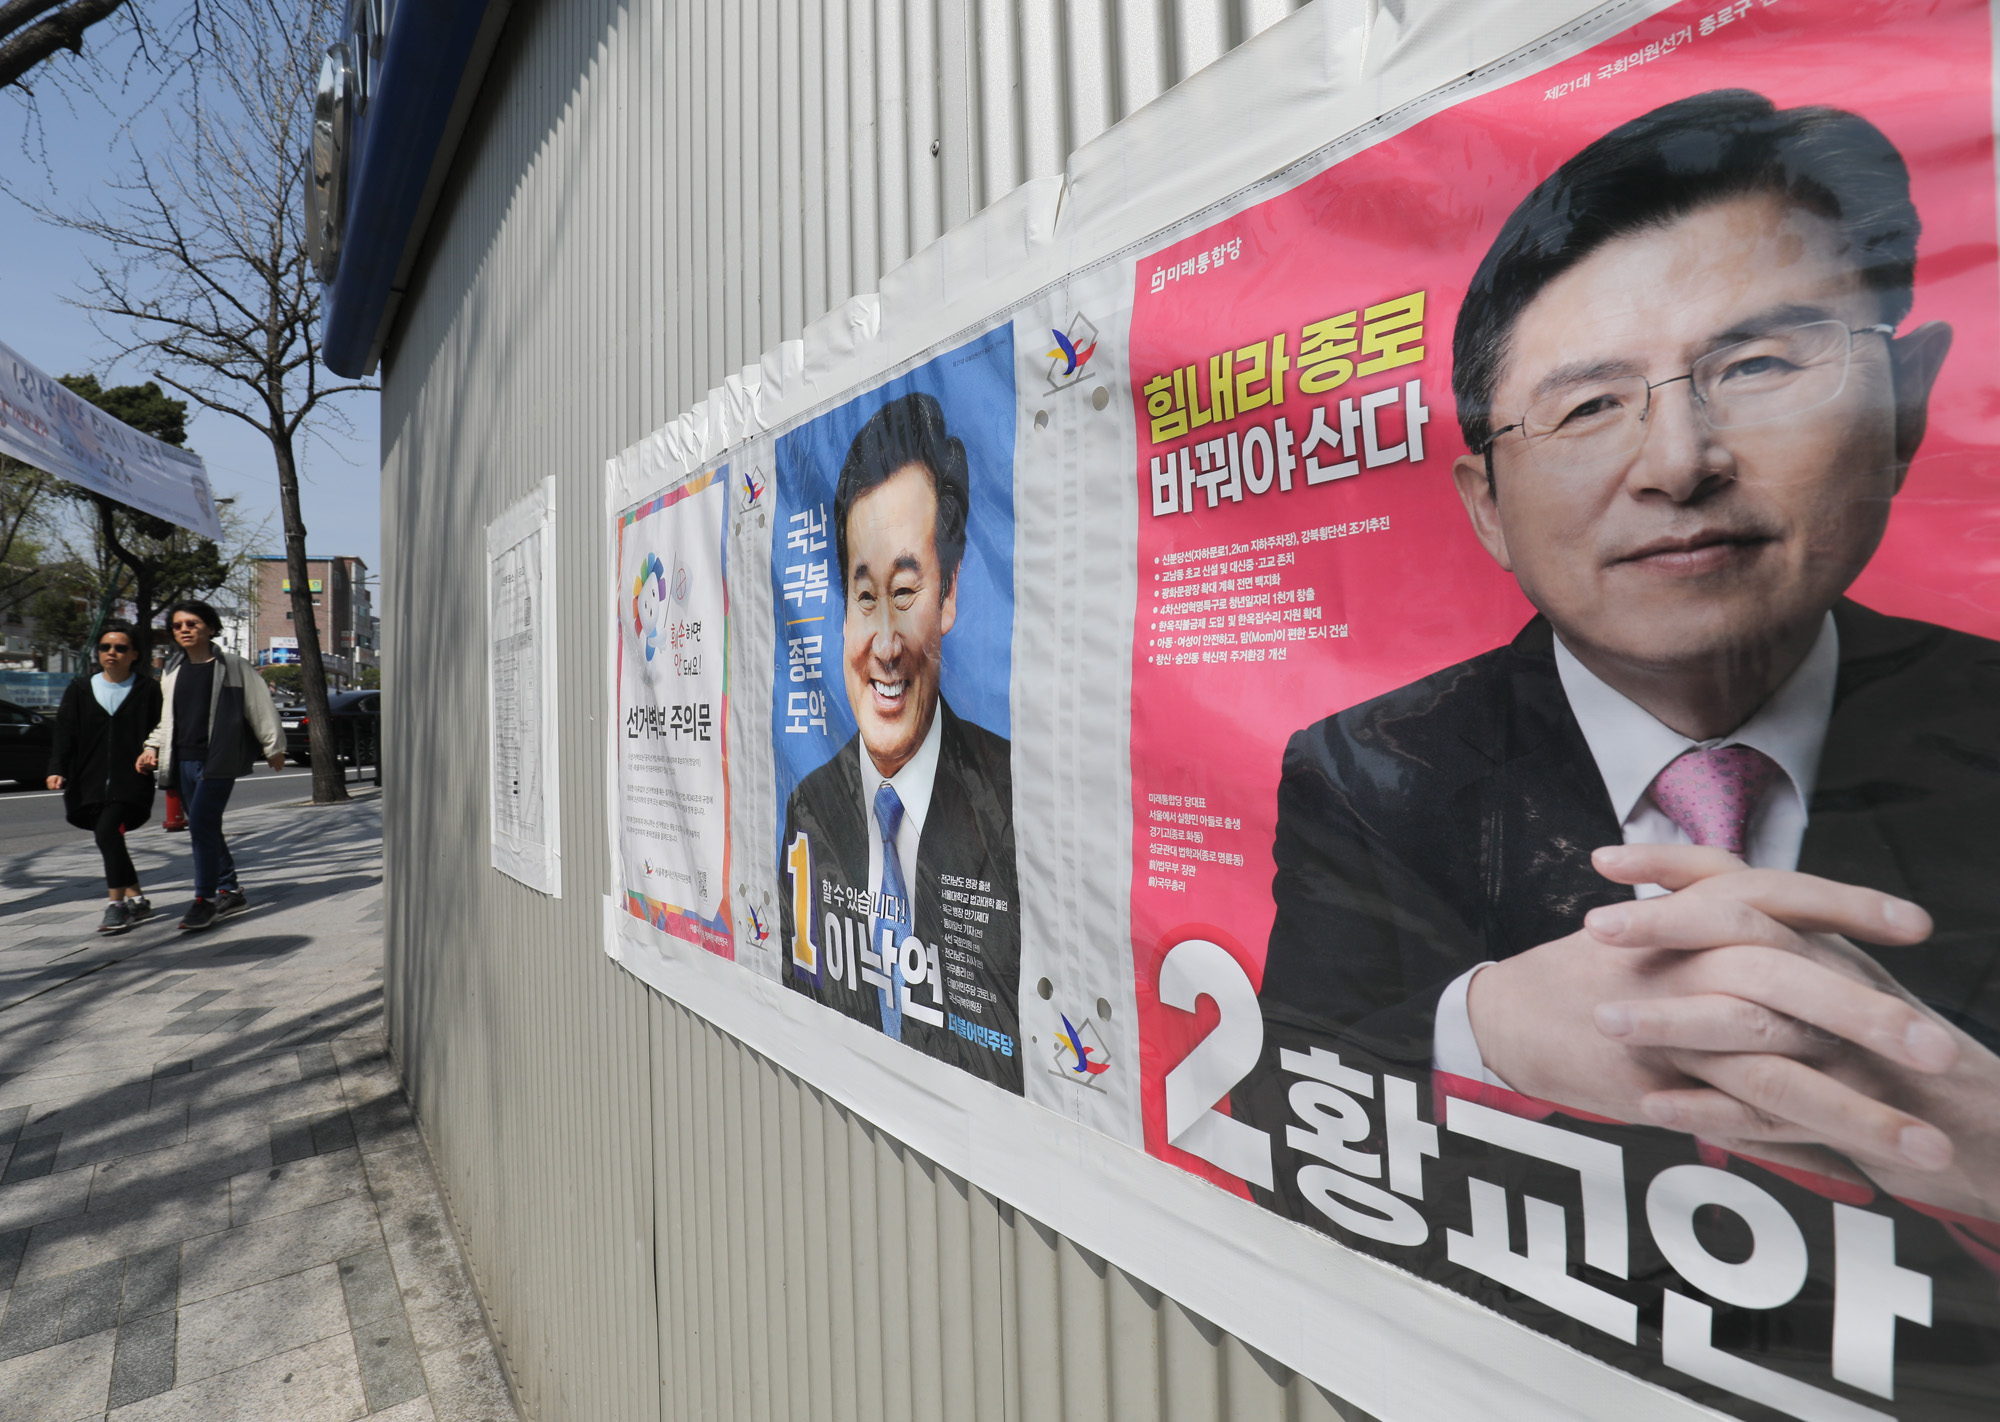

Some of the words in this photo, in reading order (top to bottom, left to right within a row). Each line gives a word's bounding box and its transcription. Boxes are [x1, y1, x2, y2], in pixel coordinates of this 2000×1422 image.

[1543, 72, 1591, 101] 제21대
[1597, 25, 1693, 80] 국회의원선거
[1698, 0, 1752, 37] 종로구
[1167, 236, 1243, 283] 미래통합당
[1143, 333, 1290, 445] 힘내라
[1297, 290, 1426, 395] 종로
[1150, 417, 1297, 517] 바꿔야
[1301, 379, 1430, 486] 산다
[787, 503, 828, 555] 국난
[1162, 543, 1249, 566] 신분당선(자하문로1.2km
[1250, 532, 1299, 551] 지하주차장),
[1301, 523, 1347, 544] 강북횡단선
[1349, 516, 1390, 535] 조기추진
[1162, 568, 1184, 582] 교남동
[1185, 566, 1201, 580] 초교
[1202, 564, 1218, 577] 신설
[1220, 561, 1228, 575] 및
[1277, 552, 1295, 567] 존치
[783, 559, 829, 608] 극복
[1161, 584, 1200, 599] 광화문광장
[1201, 581, 1217, 595] 확대
[1219, 579, 1235, 592] 계획
[1237, 576, 1253, 591] 전면
[1255, 573, 1281, 588] 백지화
[1160, 596, 1227, 616] 4차산업혁명특구로
[1229, 592, 1271, 610] 청년일자리
[1272, 590, 1295, 604] 1천개
[1296, 587, 1315, 602] 창출
[1158, 616, 1206, 632] 한옥직불금제
[1208, 615, 1225, 629] 도입
[1228, 614, 1236, 627] 및
[1238, 609, 1281, 626] 한옥집수리
[1283, 608, 1302, 623] 지원
[1303, 606, 1322, 621] 확대
[671, 619, 702, 650] 훼손하면
[1203, 632, 1238, 648] 안전하고,
[1240, 628, 1286, 645] 맘(Mom)이
[1287, 627, 1306, 641] 편한
[1308, 625, 1327, 640] 도시
[1329, 623, 1349, 639] 건설
[674, 652, 683, 677] 안
[683, 654, 702, 676] 돼요!
[788, 635, 823, 683] 종로
[1202, 650, 1228, 664] 혁신적
[1230, 648, 1265, 663] 주거환경
[1268, 647, 1287, 661] 개선
[626, 704, 667, 741] 선거벽보
[670, 702, 712, 742] 주의문
[785, 690, 828, 736] 도약
[1148, 793, 1182, 807] 미래통합당
[1184, 796, 1206, 808] 당대표
[1149, 810, 1177, 823] 서울에서
[1177, 812, 1199, 826] 실향민
[1200, 815, 1223, 828] 아들로
[1224, 817, 1241, 831] 출생
[1149, 826, 1185, 841] 경기고(종로
[1186, 830, 1204, 844] 화동)
[1149, 843, 1178, 857] 성균관대
[1178, 846, 1217, 862] 법학과(종로
[1218, 852, 1244, 867] 명륜동)
[941, 874, 965, 888] 전라남도
[965, 877, 978, 890] 영광
[978, 880, 991, 893] 출생
[1181, 864, 1196, 877] 장관
[787, 831, 818, 976] 1
[846, 887, 906, 924] 있습니다!
[941, 889, 969, 904] 서울대학교
[970, 894, 995, 909] 법과대학
[995, 899, 1008, 912] 졸업
[952, 907, 964, 919] 병장
[964, 909, 990, 924] 만기제대
[825, 911, 944, 1028] 이낙연
[944, 947, 966, 963] 전라남도
[945, 962, 966, 978] 국무총리
[948, 1012, 1014, 1057] 더불어민주당
[1160, 938, 1275, 1194] 2
[1279, 1044, 1934, 1422] 황교안
